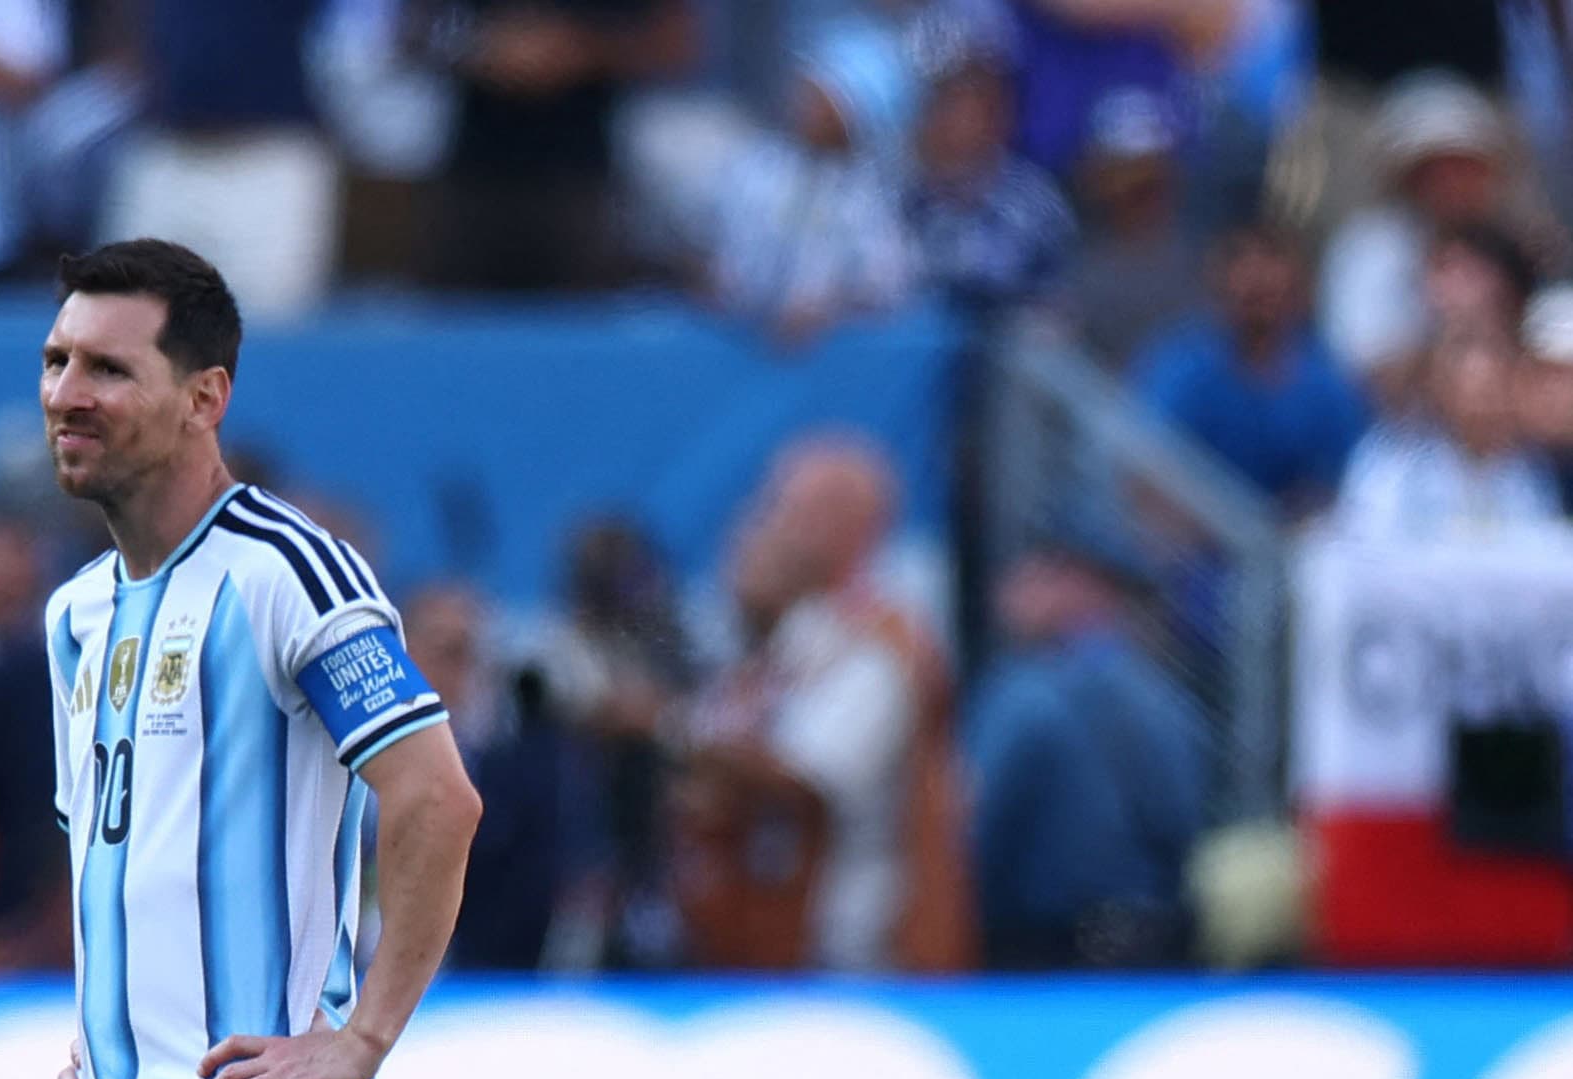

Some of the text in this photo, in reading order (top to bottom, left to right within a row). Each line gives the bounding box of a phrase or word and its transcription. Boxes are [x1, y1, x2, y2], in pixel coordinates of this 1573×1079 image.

[320, 633, 383, 673] FOOTBALL
[329, 647, 394, 692] UNITES
[338, 662, 406, 711] the World
